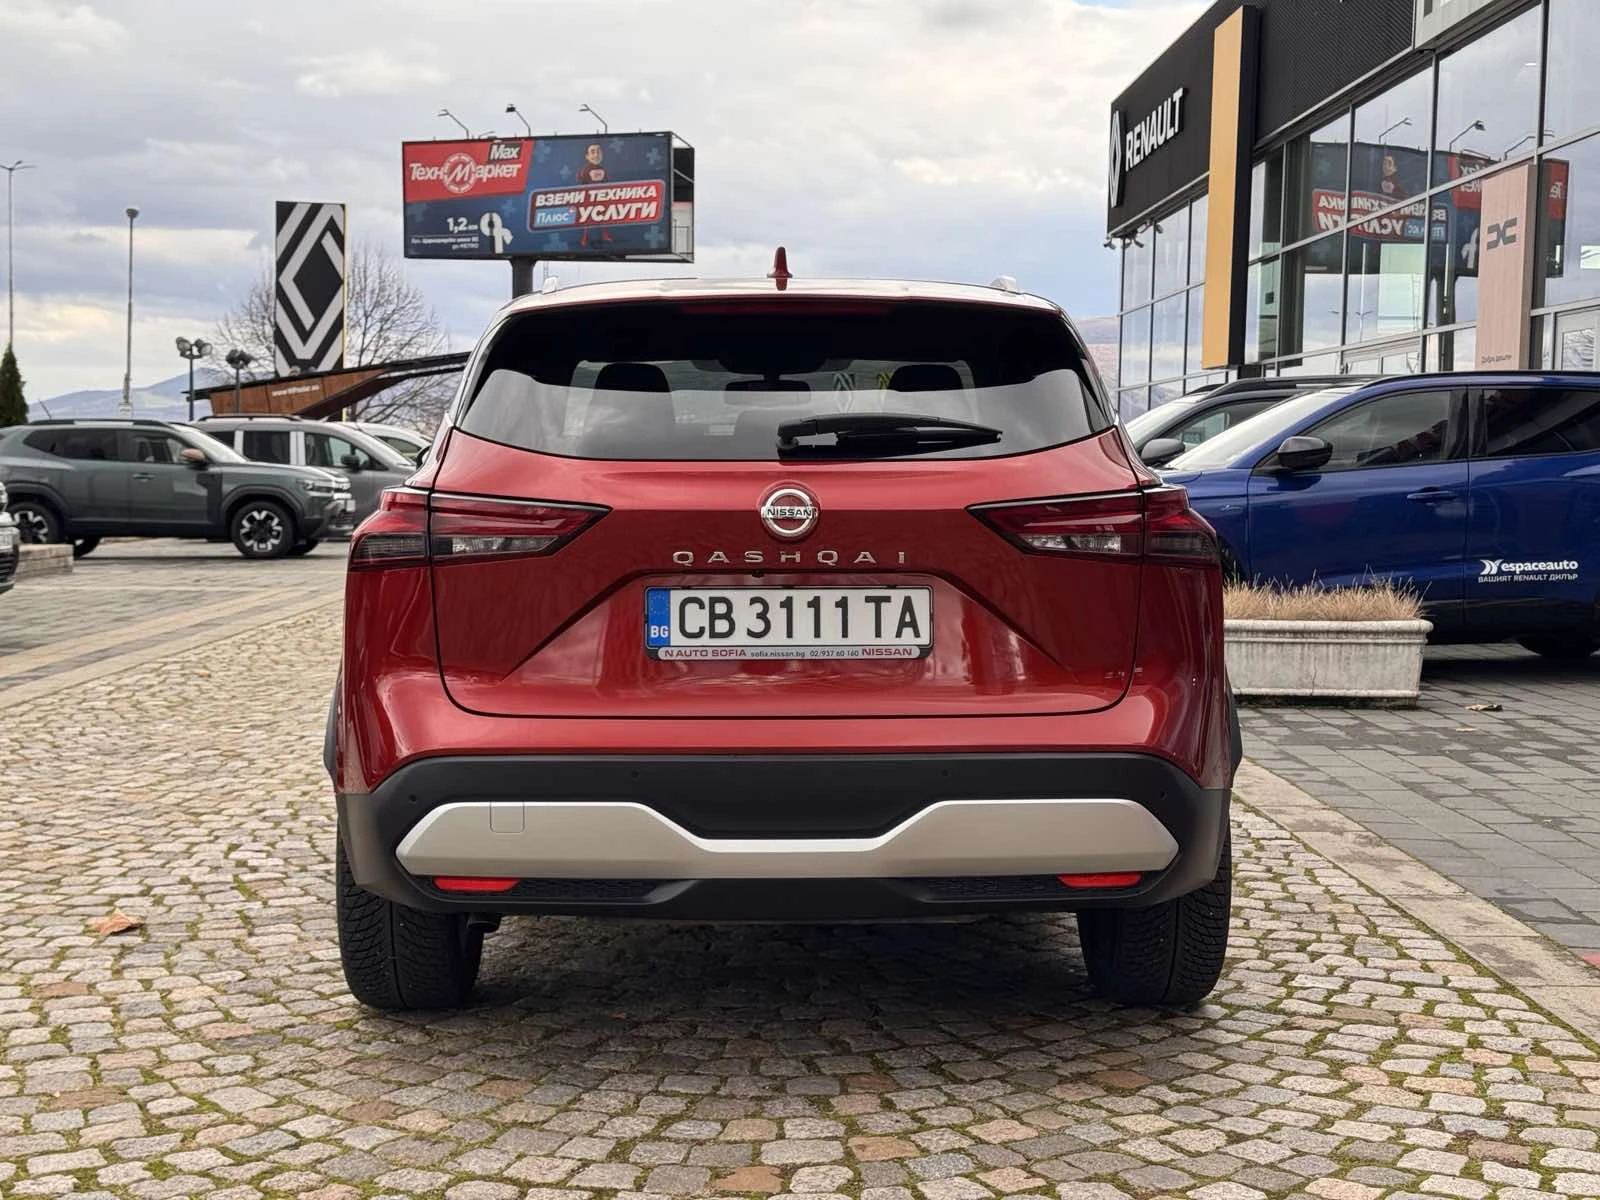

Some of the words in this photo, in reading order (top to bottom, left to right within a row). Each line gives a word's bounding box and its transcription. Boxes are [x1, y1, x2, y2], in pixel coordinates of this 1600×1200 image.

[1125, 87, 1183, 172] RENAULT
[490, 144, 520, 160] Max
[536, 191, 586, 207] ВЗЕМИ
[587, 185, 657, 202] ТЕХНИКА
[579, 202, 658, 223] УСЛУГИ
[447, 217, 468, 233] 1,2
[767, 508, 812, 517] NISSAN
[672, 550, 905, 566] QASHQAI
[1501, 560, 1579, 574] espaceauto
[1478, 575, 1511, 583] ВАШИЯТ
[1513, 574, 1547, 582] RENAULT
[678, 596, 736, 639] CB
[746, 596, 849, 638] 3111
[865, 595, 921, 638] TA
[650, 625, 669, 638] BG
[676, 649, 709, 657] AUTO
[711, 649, 747, 657] SOFIA
[750, 650, 805, 658] sofia.nissan.bg
[862, 648, 913, 656] NISSAN
